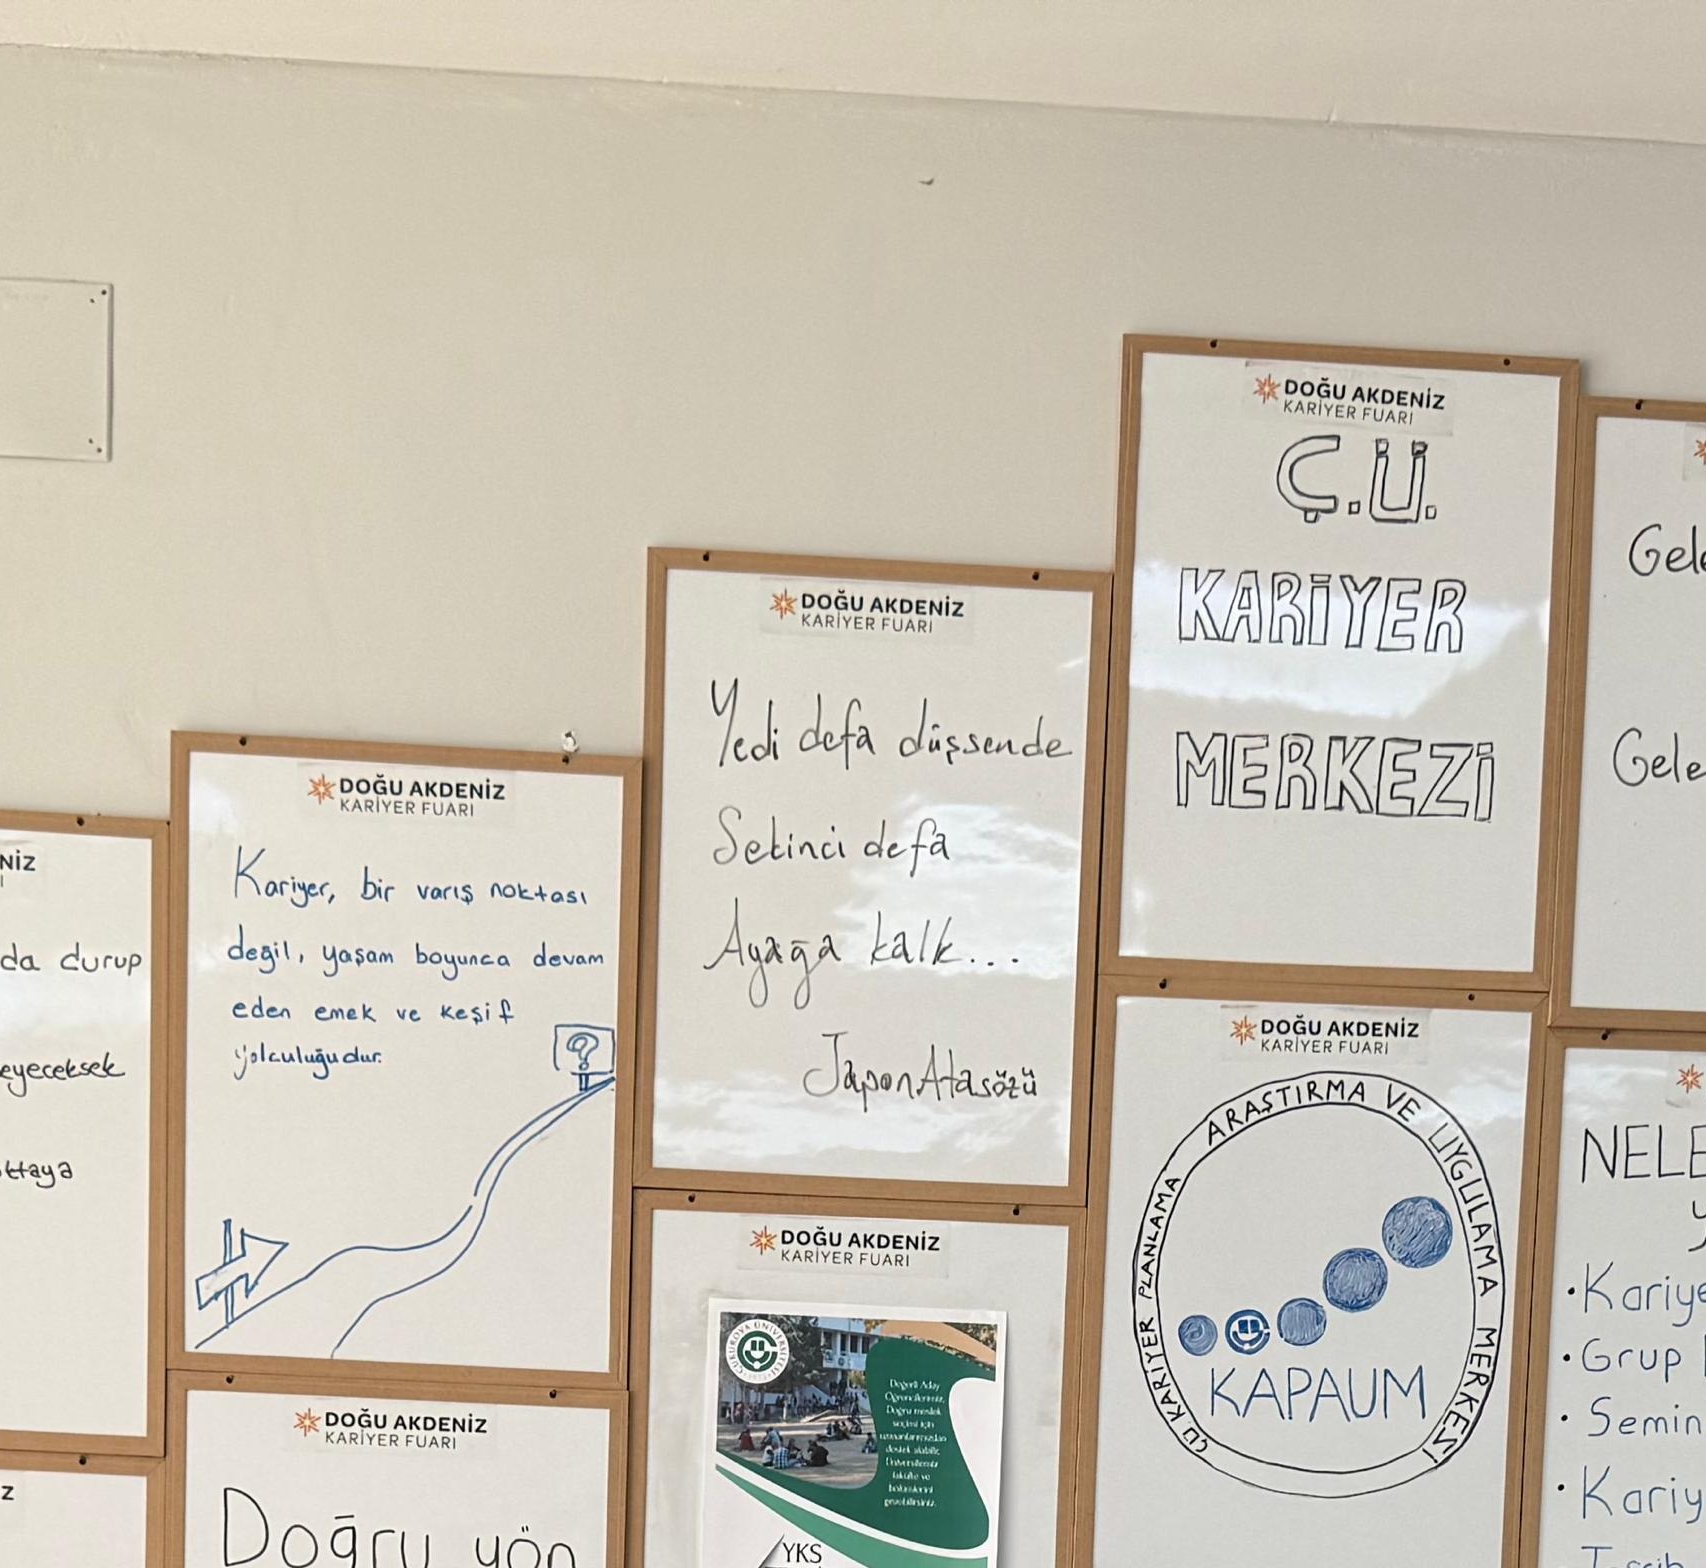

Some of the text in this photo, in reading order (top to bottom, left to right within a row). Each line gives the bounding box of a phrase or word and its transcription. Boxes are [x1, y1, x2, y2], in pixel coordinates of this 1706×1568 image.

[1283, 395, 1414, 426] KARİYER FUARI
[1284, 376, 1446, 413] DOĞU AKDENİZ
[1275, 433, 1438, 525] Ç.Ü.
[1177, 565, 1468, 655] KARİYER
[710, 676, 780, 768] Yedi
[798, 692, 877, 771] defa
[339, 772, 506, 801] DOĞU AKDENİZ
[340, 795, 474, 817] KARİYER FUARI
[1175, 730, 1496, 825] MERKEZİ
[234, 844, 588, 909] Kariyer, bir varış noktası
[863, 817, 951, 879] defa
[59, 945, 143, 977] durup
[227, 923, 604, 982] değil, yaşam boyunca devam
[231, 997, 292, 1020] eden
[314, 1002, 377, 1023] emek
[395, 1008, 422, 1023] ve
[1207, 1079, 1365, 1146] ARAŞTIRMA
[1387, 1082, 1421, 1122] VE
[1139, 1177, 1181, 1299] PLANLAMA
[1428, 1123, 1500, 1298] UYGULAMA
[1140, 1316, 1187, 1422] KARİYER
[1581, 1337, 1682, 1384] Grup
[1210, 1364, 1427, 1423] KAPAUM
[783, 1542, 822, 1564] YKS
